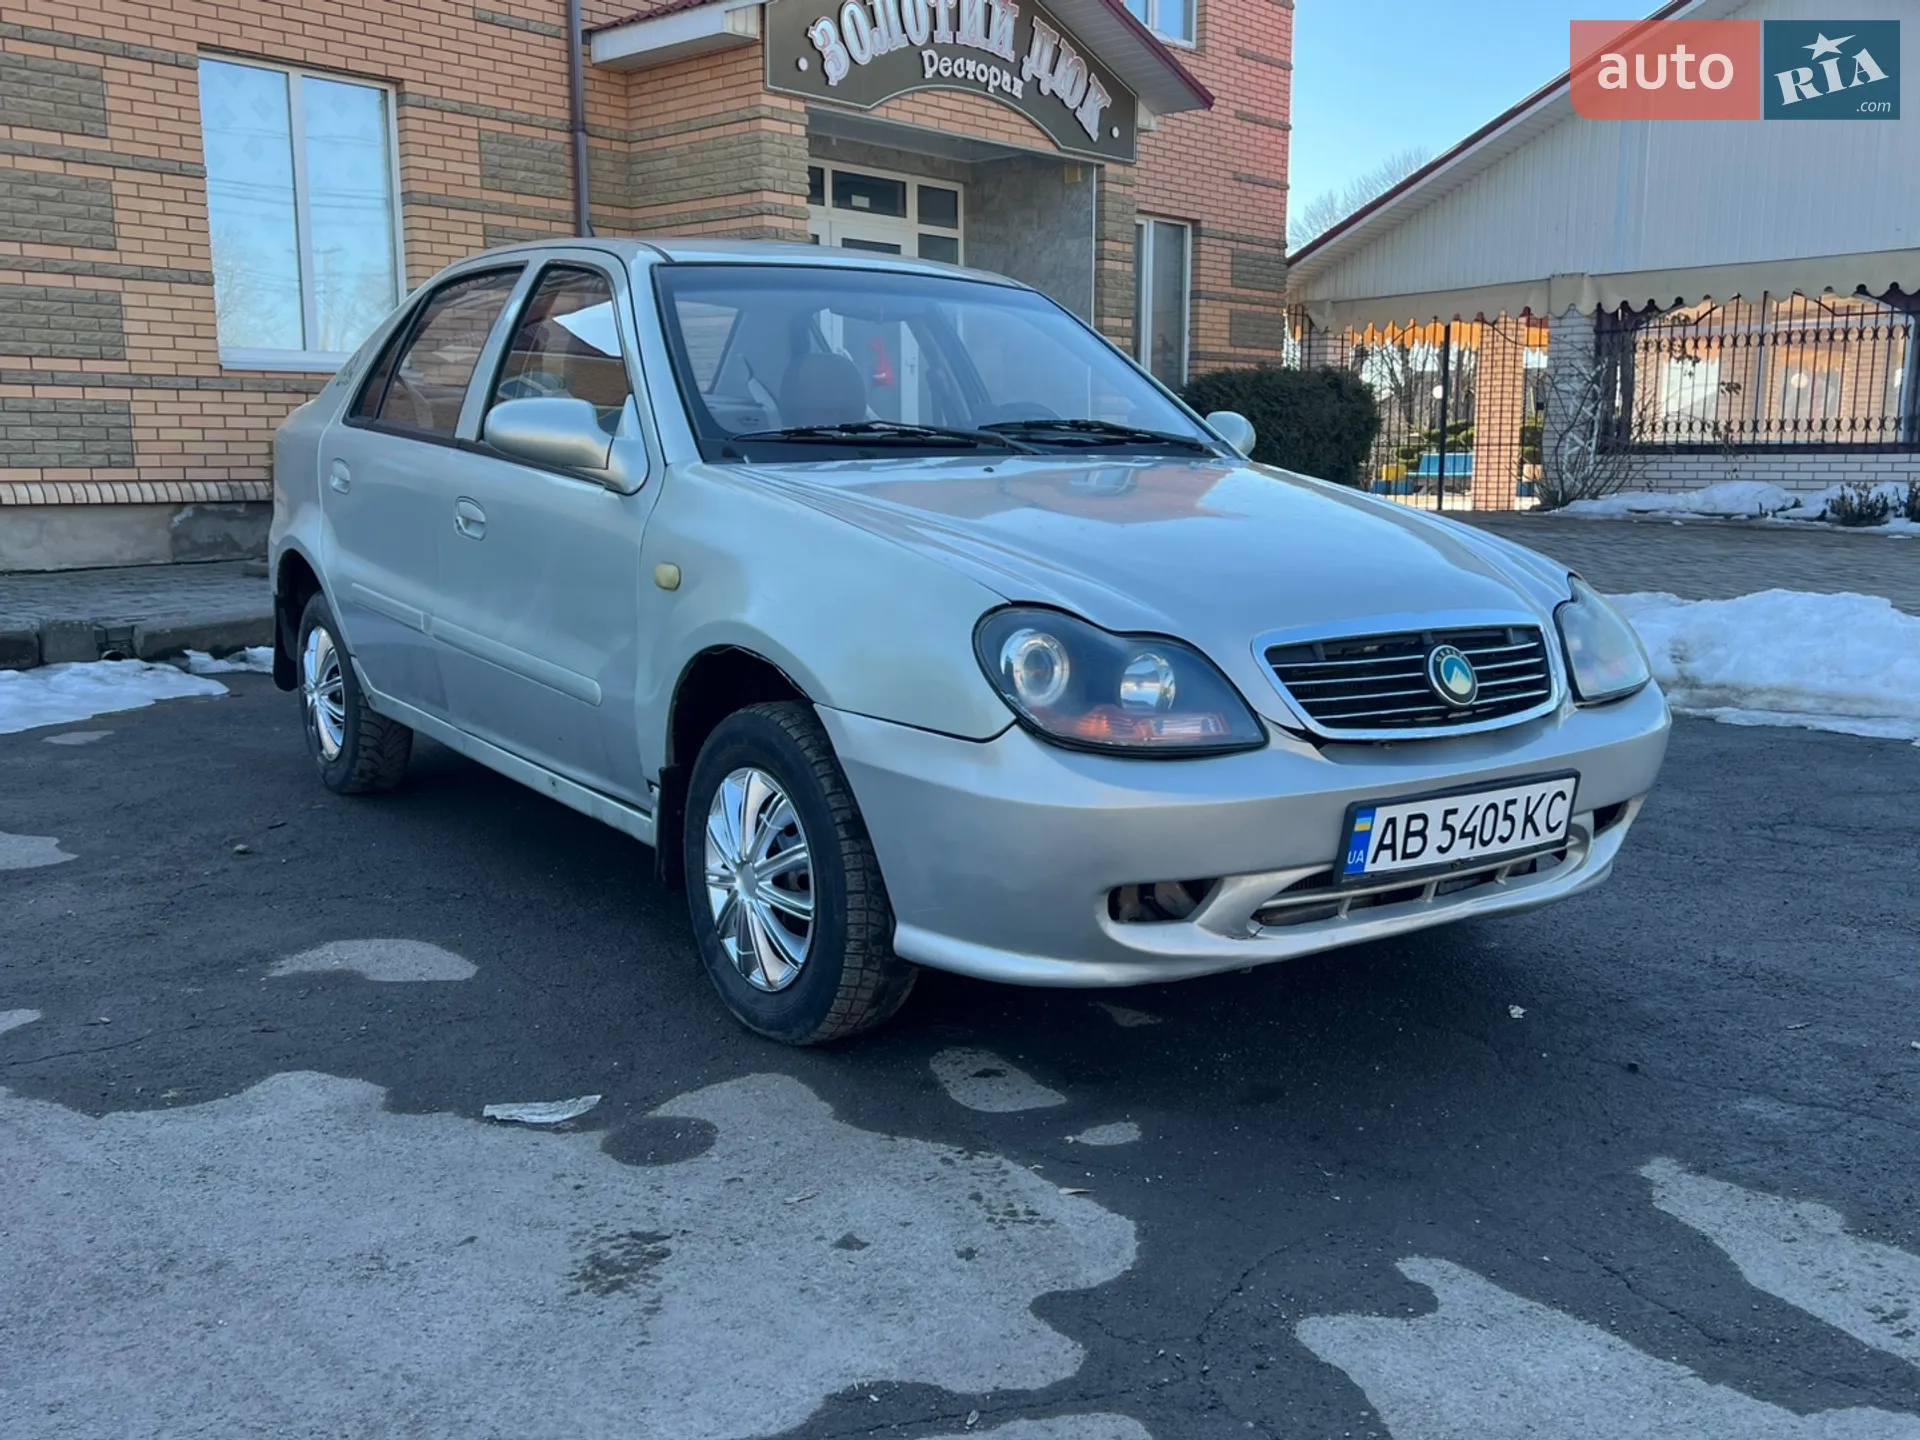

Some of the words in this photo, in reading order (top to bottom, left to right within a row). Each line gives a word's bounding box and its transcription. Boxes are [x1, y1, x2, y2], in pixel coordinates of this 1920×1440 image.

[921, 49, 1024, 99] Ресторан
[1021, 15, 1112, 142] ДЮК
[1346, 850, 1365, 866] UA
